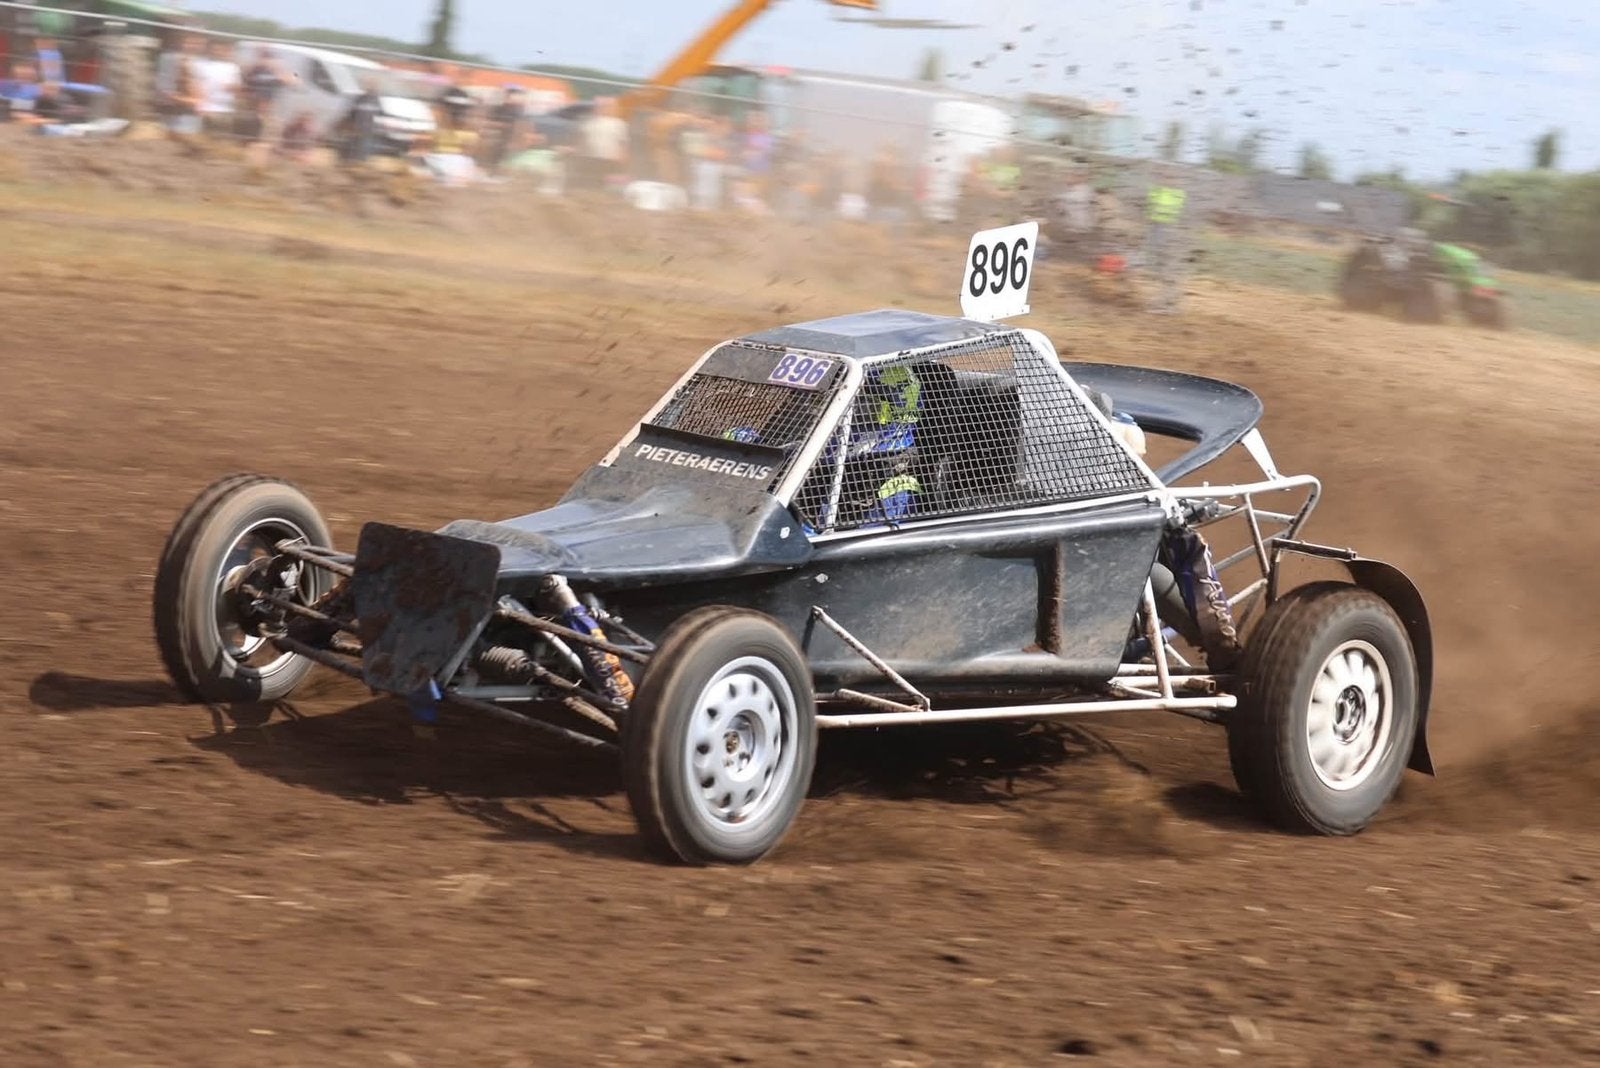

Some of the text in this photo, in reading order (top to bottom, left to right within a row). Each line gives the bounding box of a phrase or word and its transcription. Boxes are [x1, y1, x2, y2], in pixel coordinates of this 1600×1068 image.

[969, 237, 1029, 297] 896
[771, 354, 831, 385] 896
[634, 443, 773, 480] PIETERAERENS
